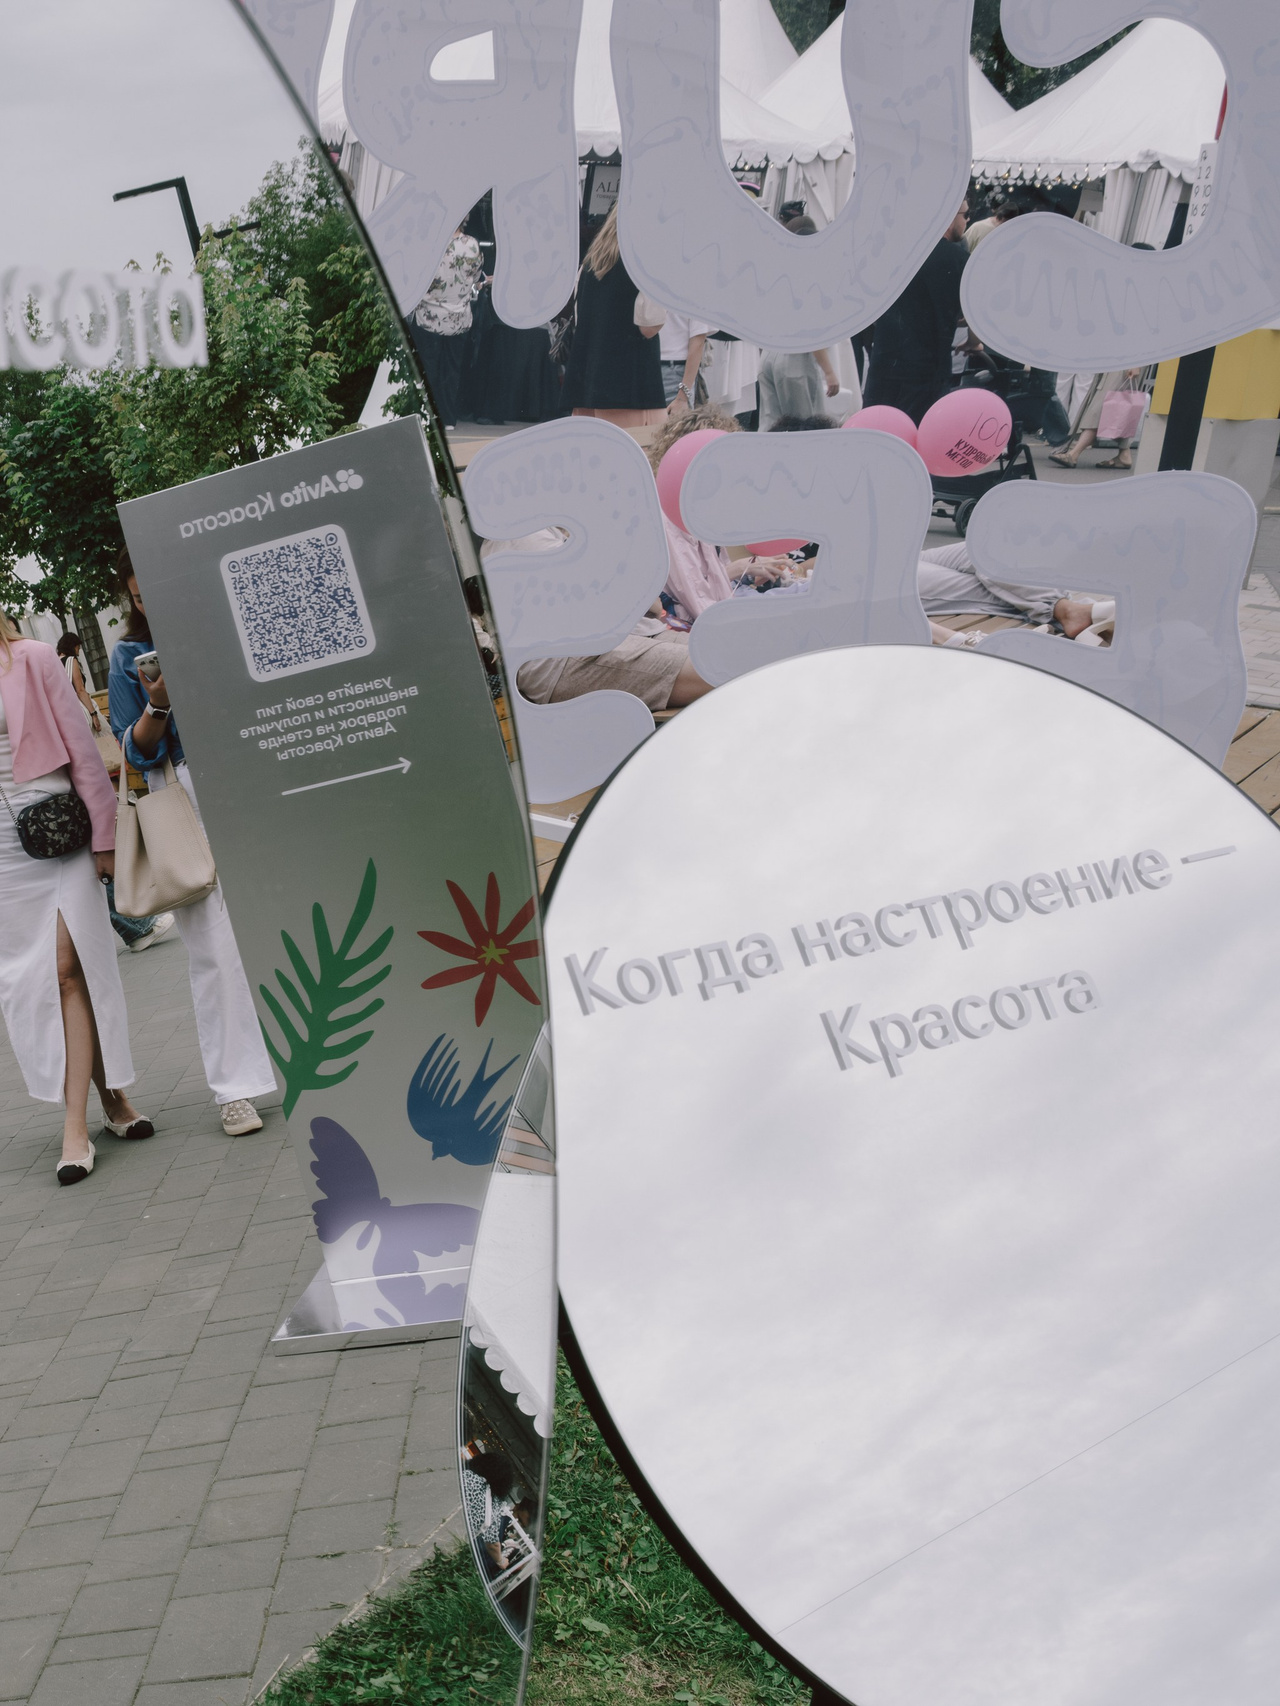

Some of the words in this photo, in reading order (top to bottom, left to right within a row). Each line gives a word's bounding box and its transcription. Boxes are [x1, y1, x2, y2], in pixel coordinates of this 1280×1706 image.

[945, 448, 974, 469] МЕТОД
[563, 932, 785, 1017] Когда
[791, 845, 1174, 968] настроение
[820, 968, 1103, 1078] Красота
